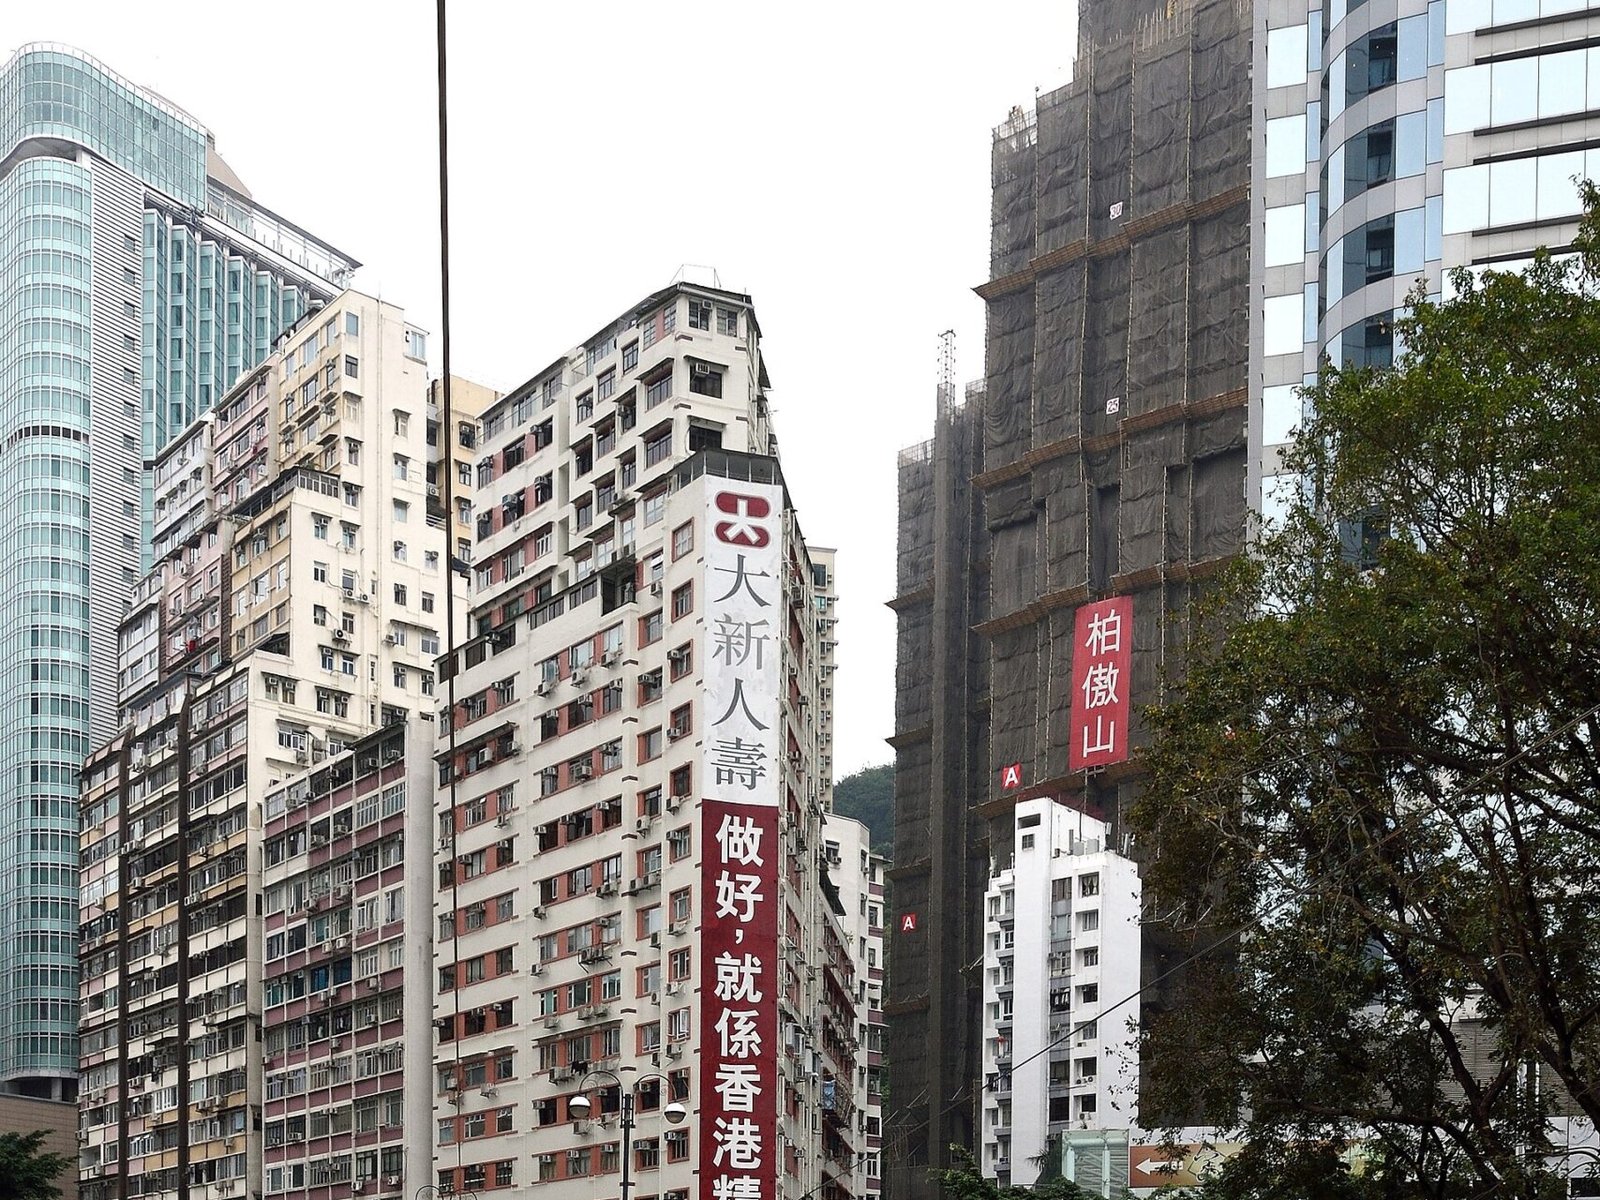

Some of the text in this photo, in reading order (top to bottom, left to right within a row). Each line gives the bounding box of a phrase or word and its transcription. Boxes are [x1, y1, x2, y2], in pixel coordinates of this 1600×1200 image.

[711, 553, 771, 791] 大新人壽
[1082, 608, 1122, 758] 柏傲山
[1005, 766, 1019, 786] A
[903, 916, 915, 930] A
